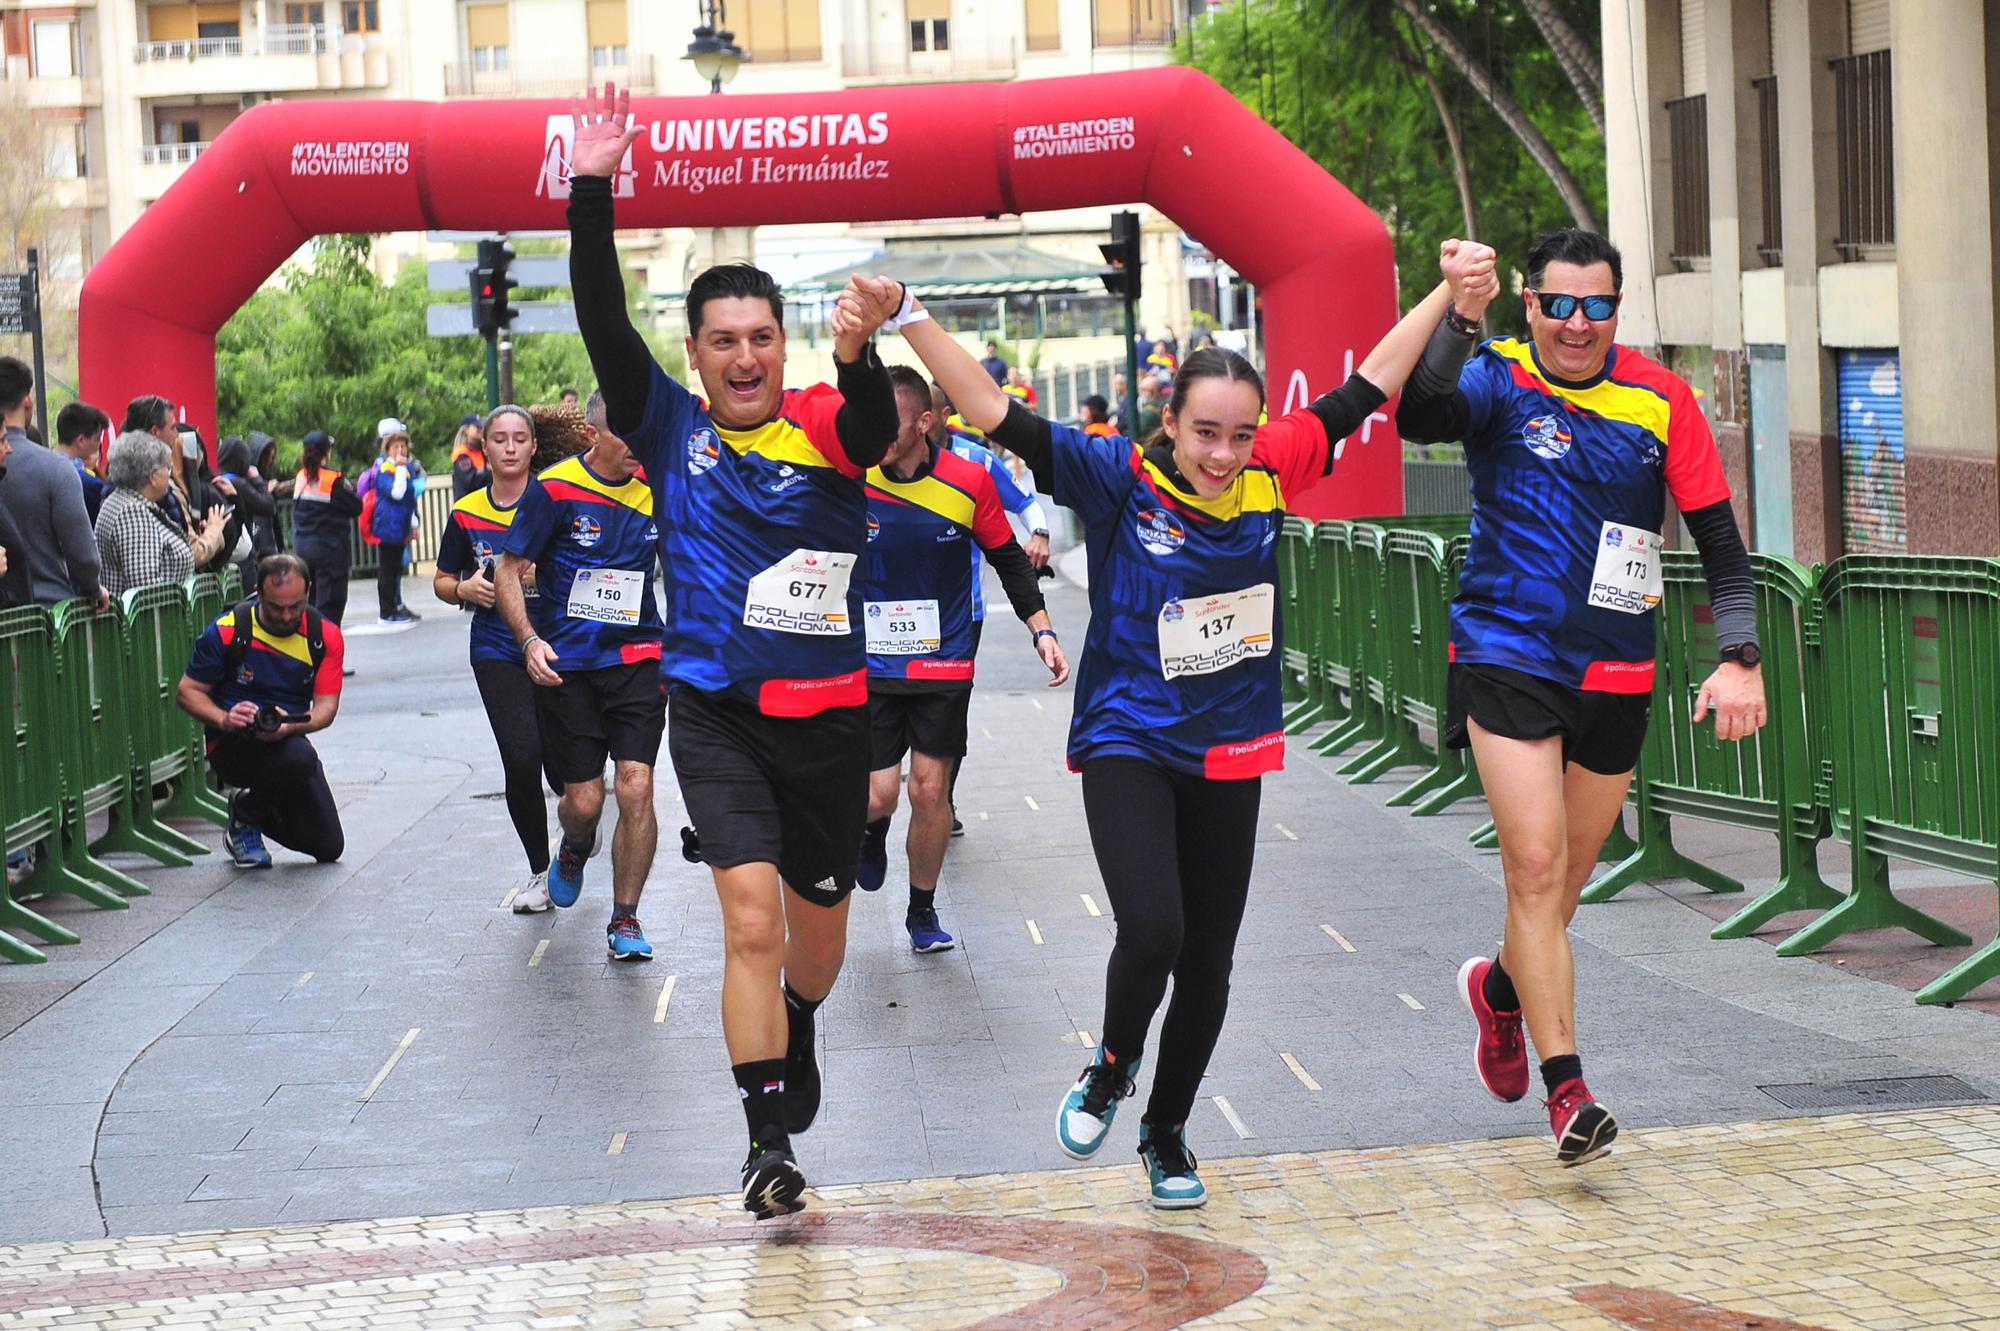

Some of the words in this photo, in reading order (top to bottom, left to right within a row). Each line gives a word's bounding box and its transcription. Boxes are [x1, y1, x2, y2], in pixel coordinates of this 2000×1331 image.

[650, 111, 889, 153] UNIVERSITAS
[1014, 116, 1135, 143] #TALENTOEN
[291, 141, 410, 160] #TALENTOEN
[1014, 133, 1136, 160] MOVIMIENTO
[290, 158, 410, 176] MOVIMIENTO
[653, 158, 743, 194] Miguel
[750, 153, 889, 184] Hernández
[789, 564, 828, 577] Santander
[1625, 560, 1647, 580] 173
[596, 588, 621, 601] 150
[789, 580, 827, 600] 677
[1593, 582, 1645, 601] POLICIA
[568, 608, 638, 624] NACIONAL
[569, 602, 625, 616] POLICIA
[749, 604, 827, 623] POLICIA
[1194, 602, 1231, 618] Santander
[747, 613, 849, 633] NACIONAL
[889, 621, 916, 633] 533
[1199, 613, 1236, 640] 137
[867, 639, 924, 648] POLICIA
[867, 645, 939, 654] NACIONAL
[1164, 637, 1246, 667] POLICIA
[1165, 643, 1270, 676] NACIONAL
